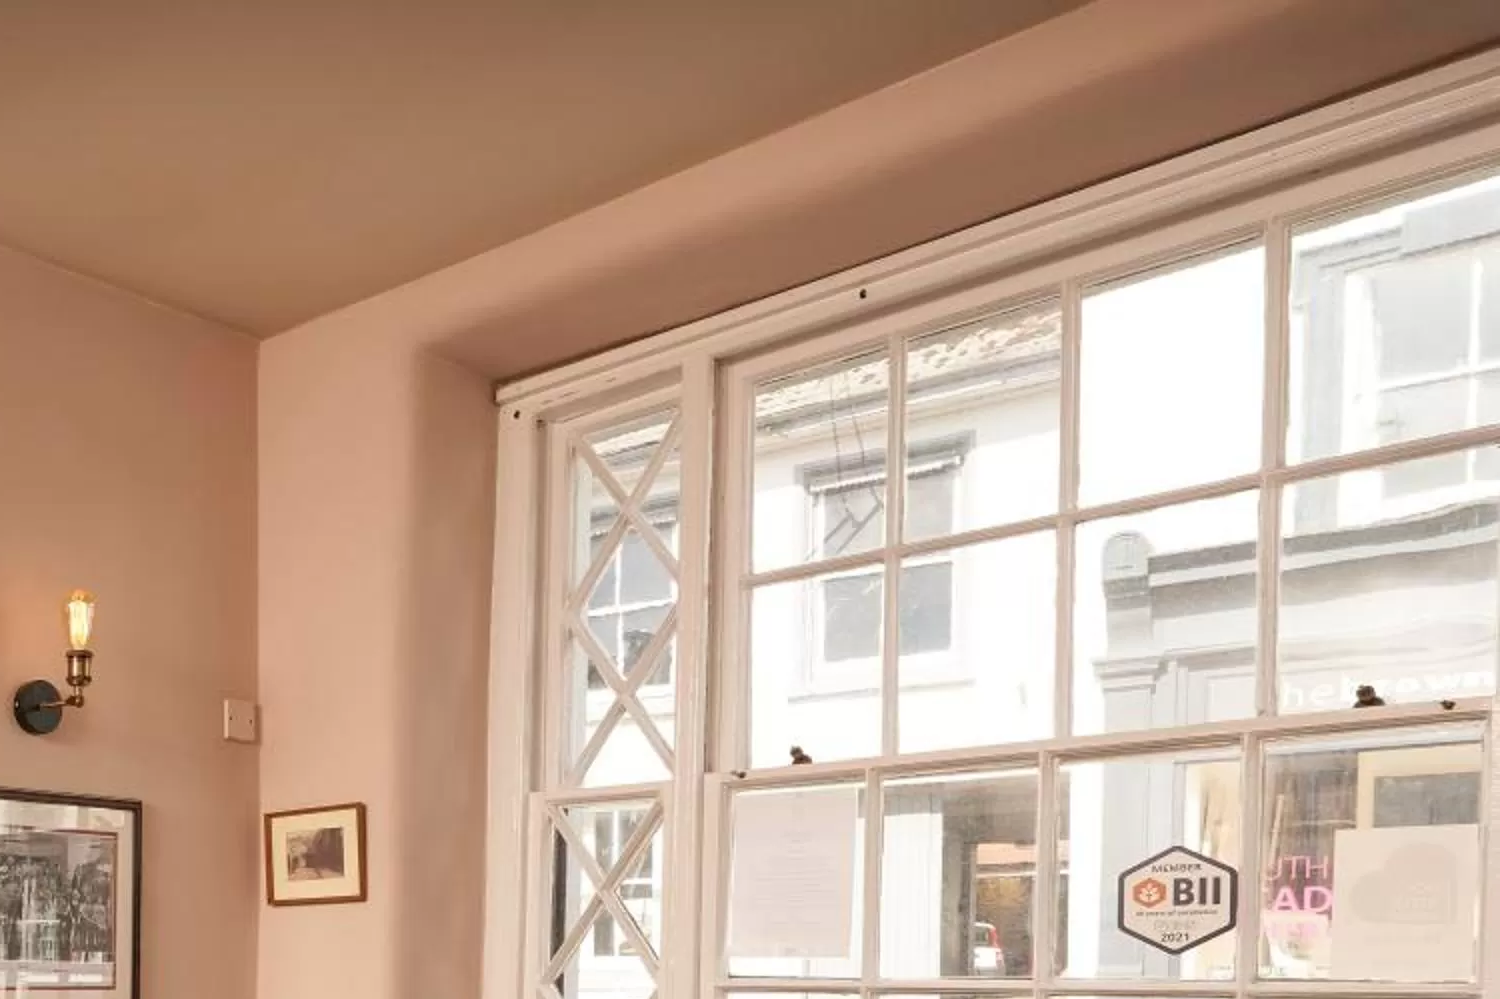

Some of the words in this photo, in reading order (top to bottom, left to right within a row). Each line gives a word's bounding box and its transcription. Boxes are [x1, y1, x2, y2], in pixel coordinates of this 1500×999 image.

[1151, 863, 1203, 874] MEMBER
[1173, 876, 1222, 907] BII
[1161, 931, 1190, 943] 2021
